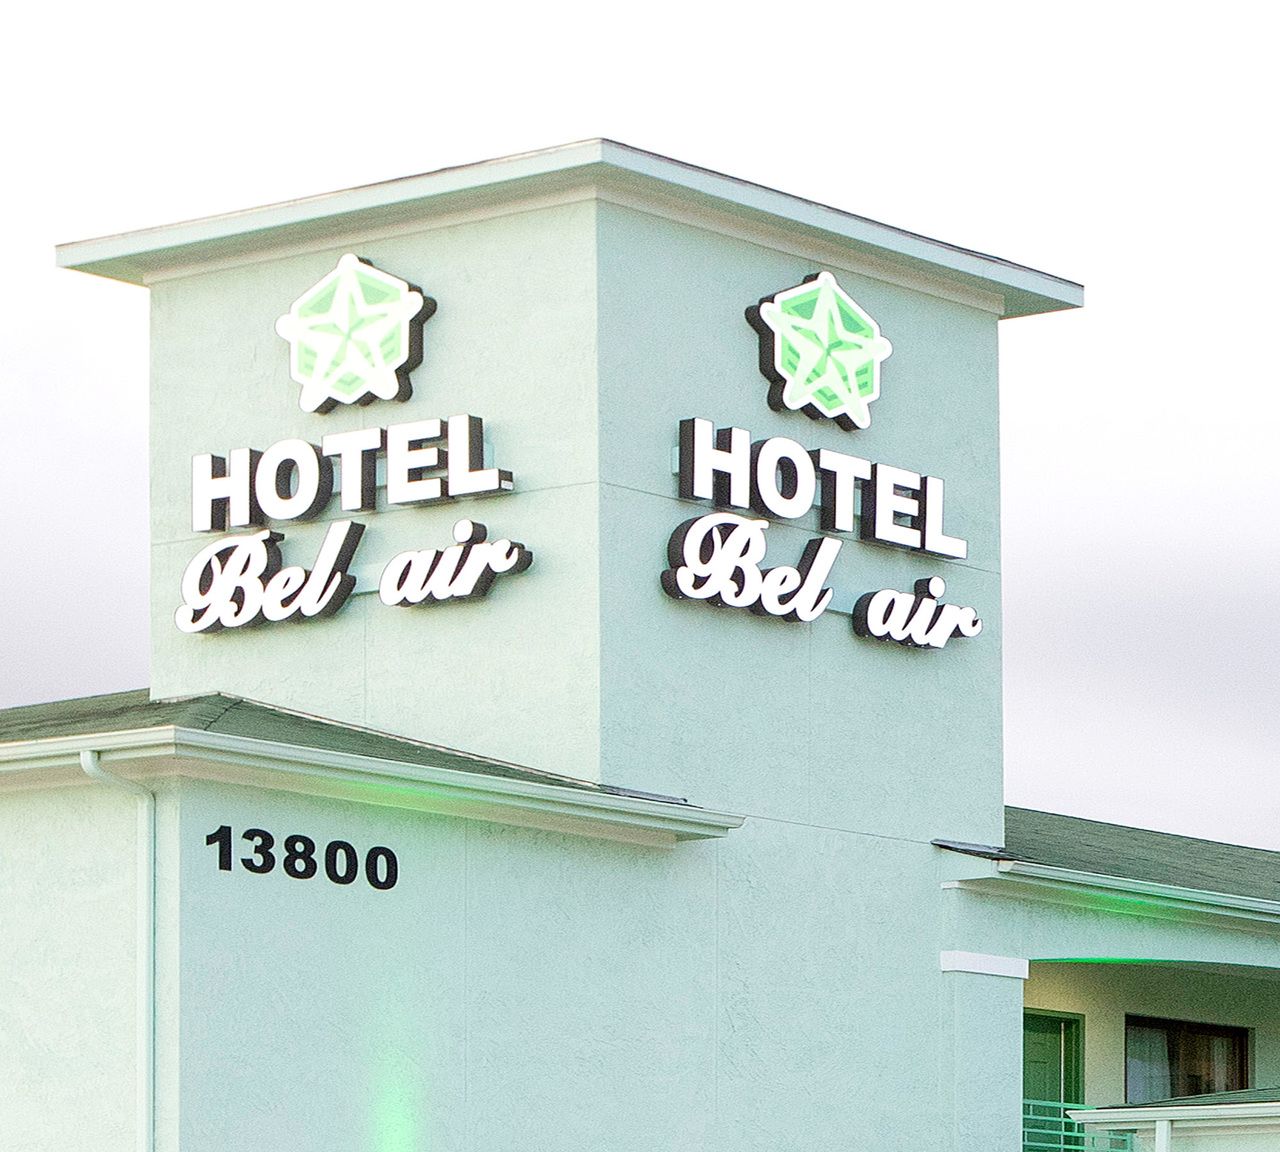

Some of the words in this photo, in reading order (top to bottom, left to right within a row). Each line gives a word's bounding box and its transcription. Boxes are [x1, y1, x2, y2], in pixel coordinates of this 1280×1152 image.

[192, 414, 510, 533] HOTEL
[680, 417, 968, 560] HOTEL
[175, 520, 364, 633] Bel
[379, 519, 530, 607] air
[662, 512, 843, 622] Bel
[854, 576, 983, 649] air
[206, 825, 398, 890] 13800
